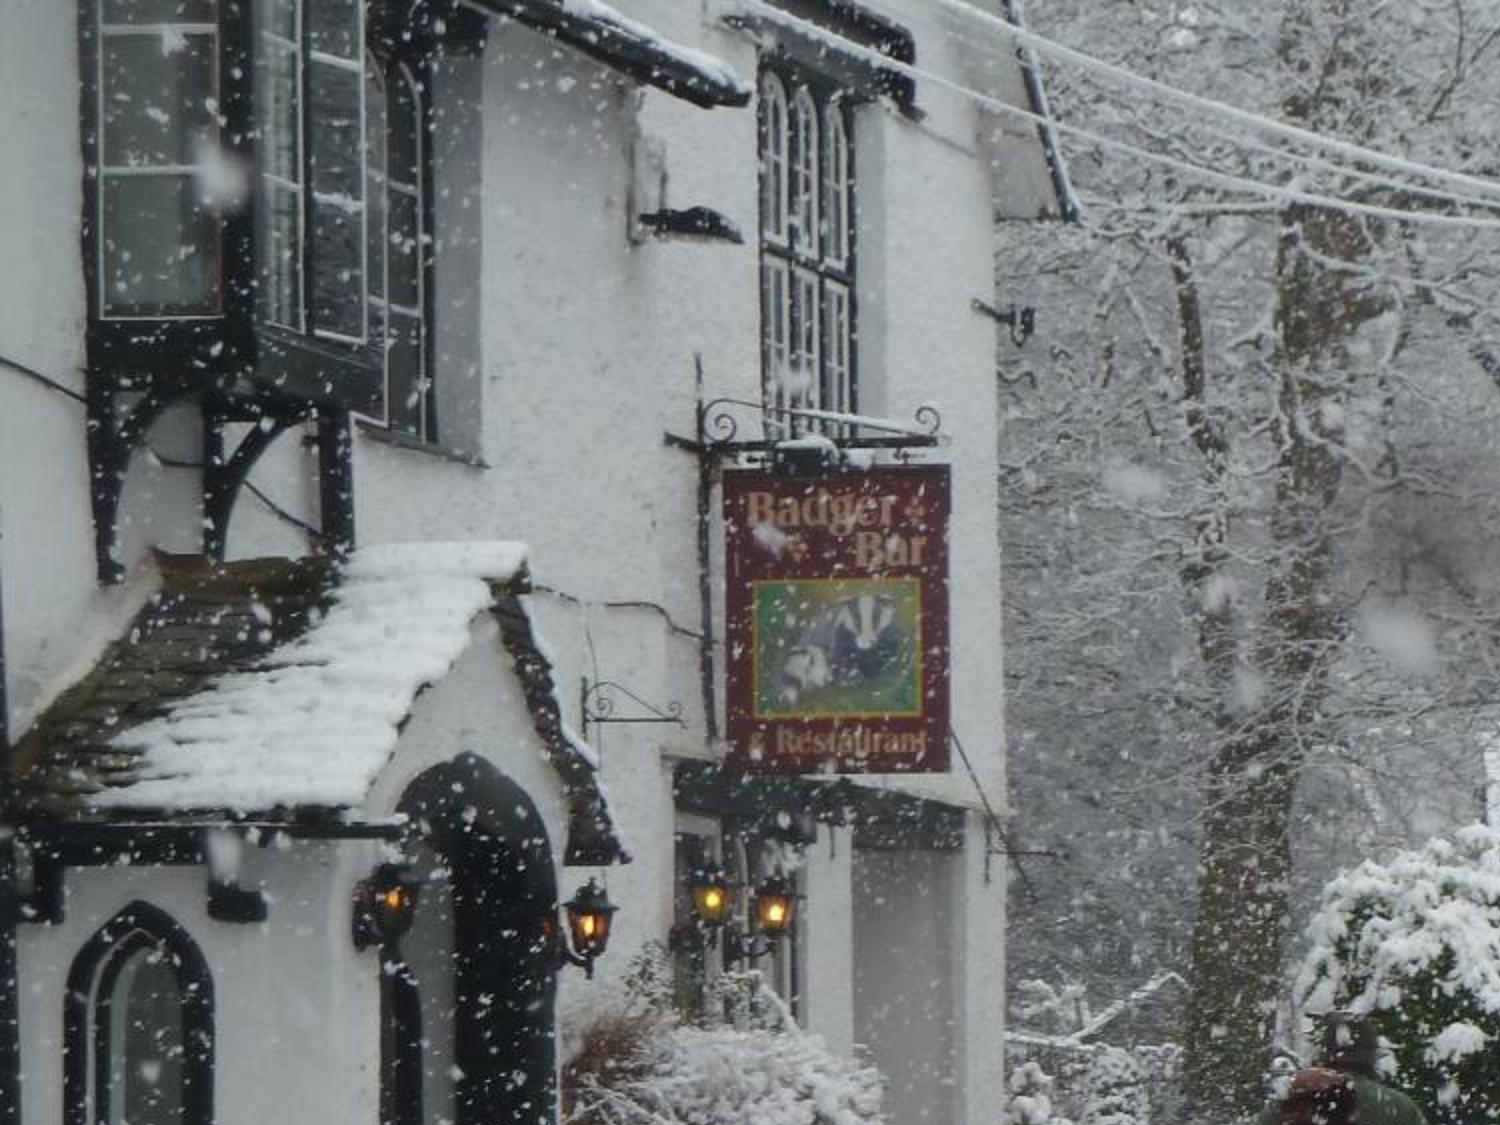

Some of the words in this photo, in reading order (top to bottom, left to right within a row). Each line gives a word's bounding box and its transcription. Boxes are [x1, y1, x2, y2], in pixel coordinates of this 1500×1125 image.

[747, 488, 897, 535] Badger
[854, 531, 929, 568] Bar
[777, 727, 929, 755] Restaurant
